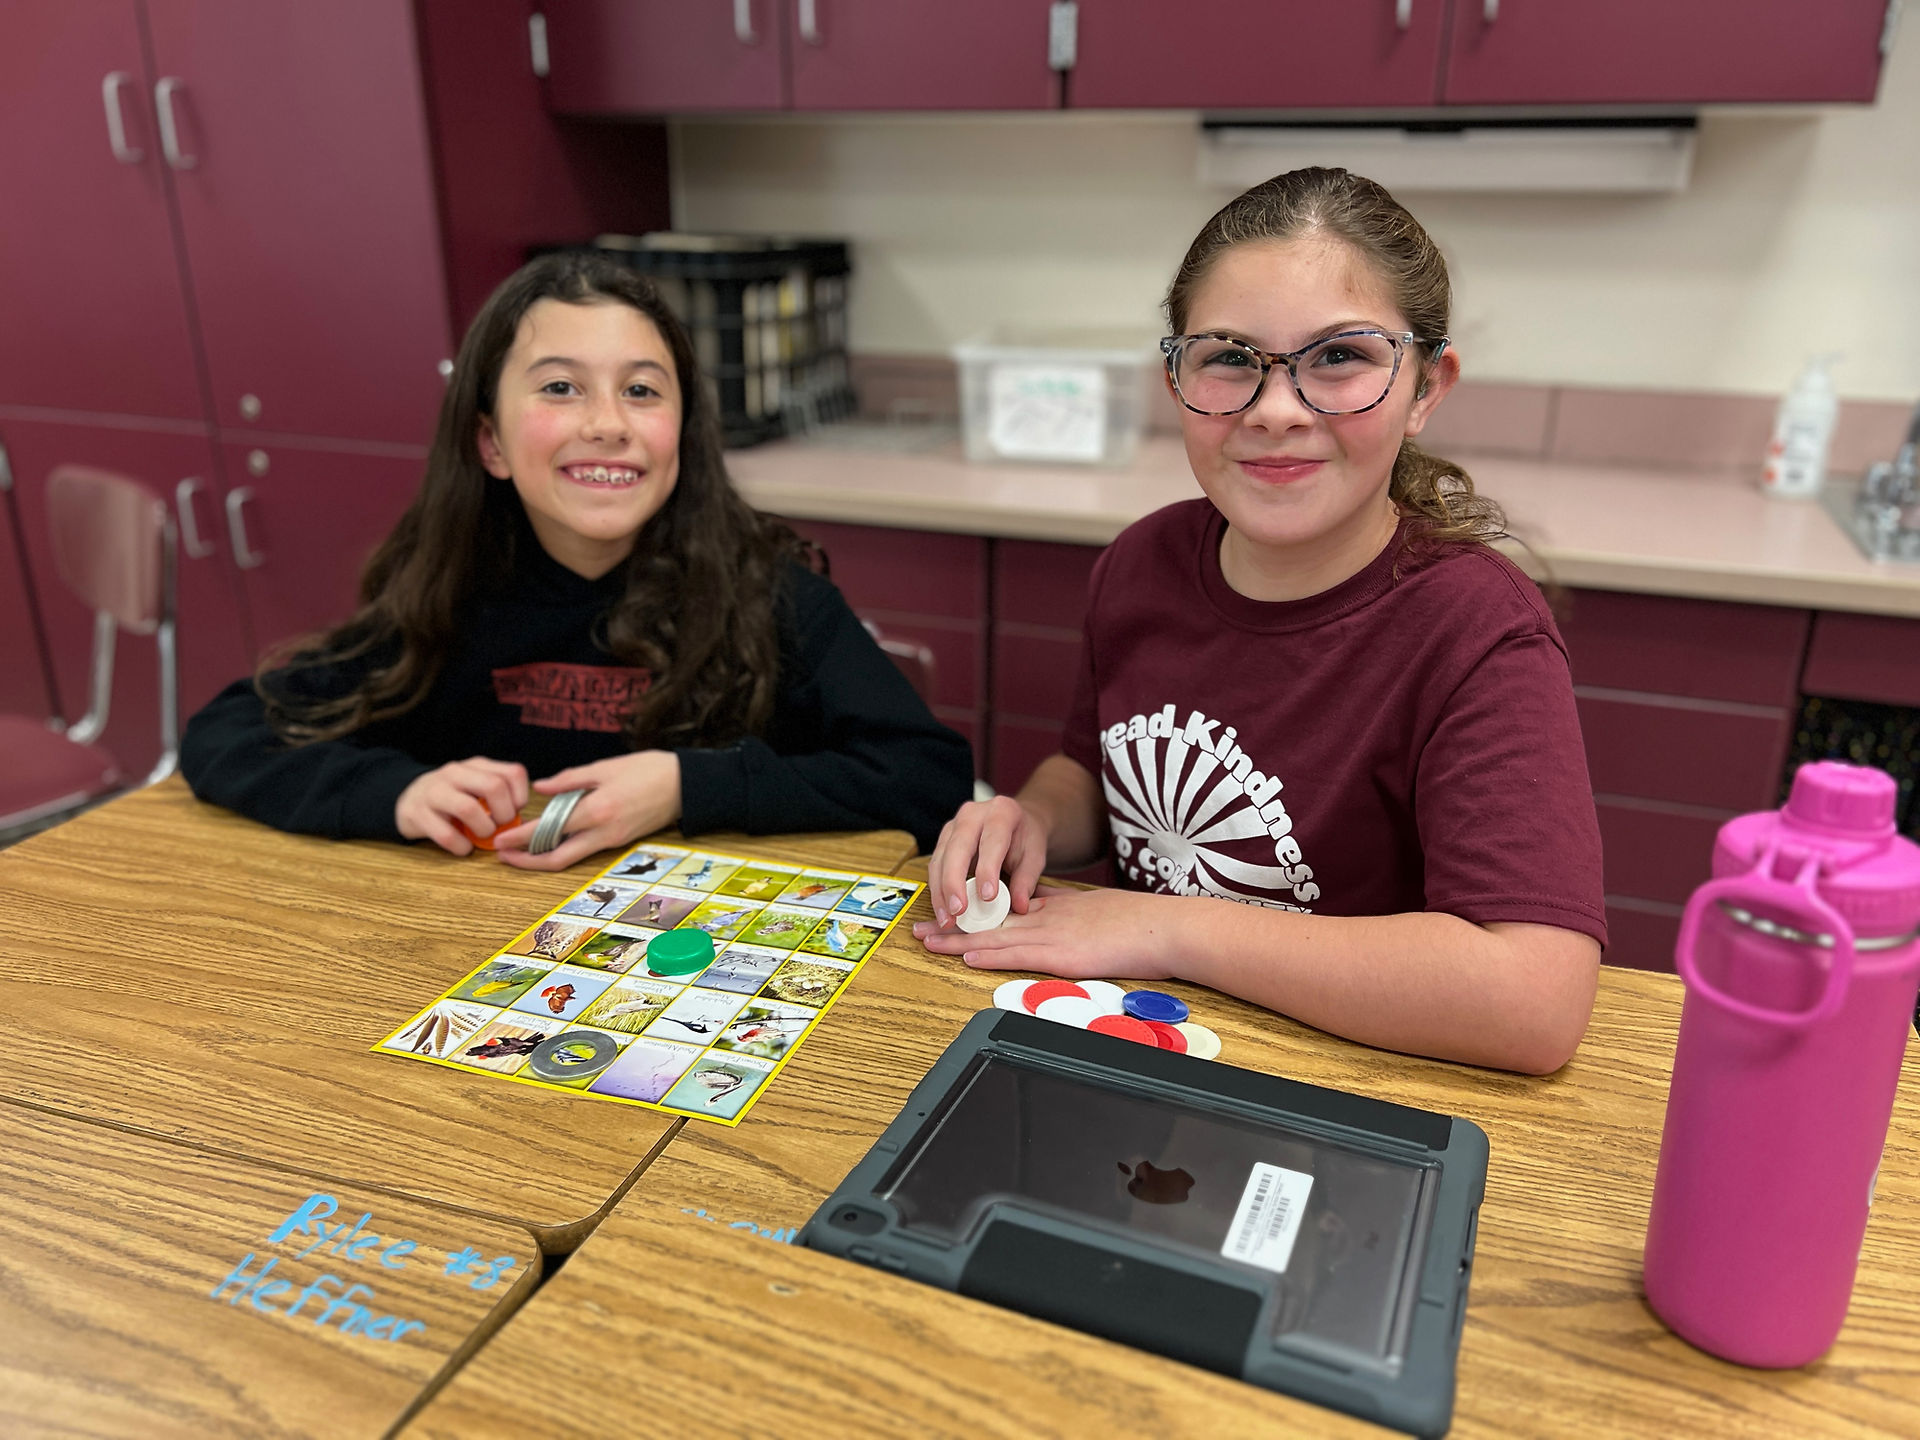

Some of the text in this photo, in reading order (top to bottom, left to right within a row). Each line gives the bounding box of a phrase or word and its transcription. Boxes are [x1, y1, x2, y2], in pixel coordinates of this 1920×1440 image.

[1182, 710, 1320, 902] Kindness
[267, 1194, 516, 1290] Rylee #8
[209, 1252, 427, 1342] Heffner
